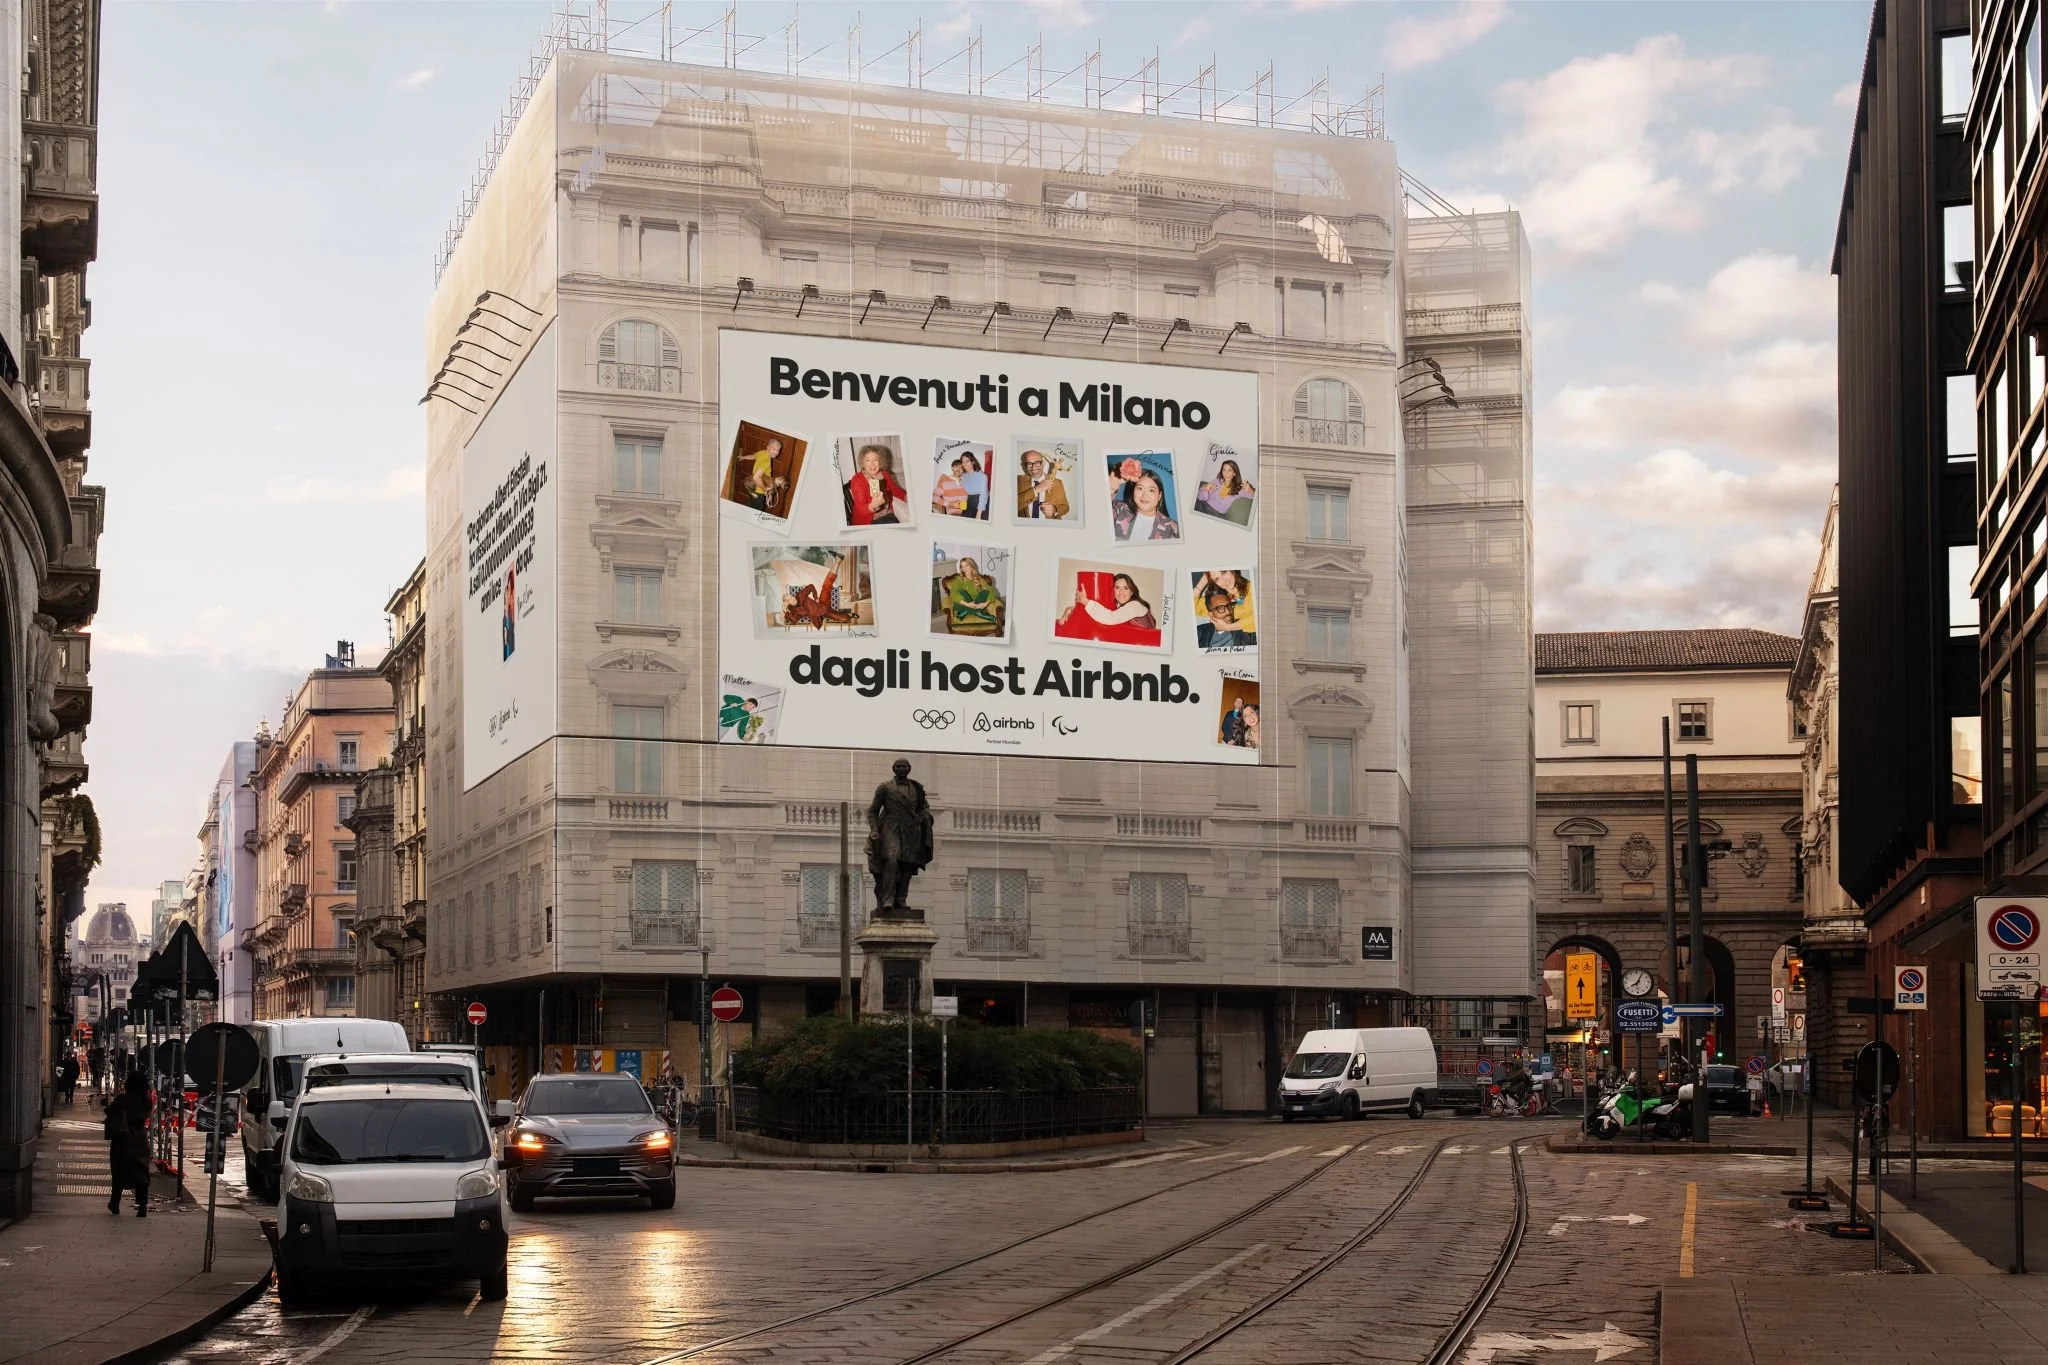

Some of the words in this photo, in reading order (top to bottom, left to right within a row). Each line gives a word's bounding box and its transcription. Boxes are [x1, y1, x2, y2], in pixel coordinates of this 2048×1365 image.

[771, 357, 1009, 413] Benvenuti
[1018, 386, 1048, 417] a
[1060, 381, 1211, 431] Milano
[1208, 443, 1238, 461] Giulia
[494, 474, 510, 514] Albert
[510, 451, 530, 494] Einstein
[519, 484, 527, 512] Via
[469, 577, 474, 600] A
[481, 581, 492, 614] anni
[516, 550, 523, 576] da
[723, 674, 752, 685] Matteo
[790, 645, 910, 698] dagli
[921, 651, 1026, 696] host
[1033, 658, 1200, 703] Airbnb.
[993, 717, 1035, 729] airbnb
